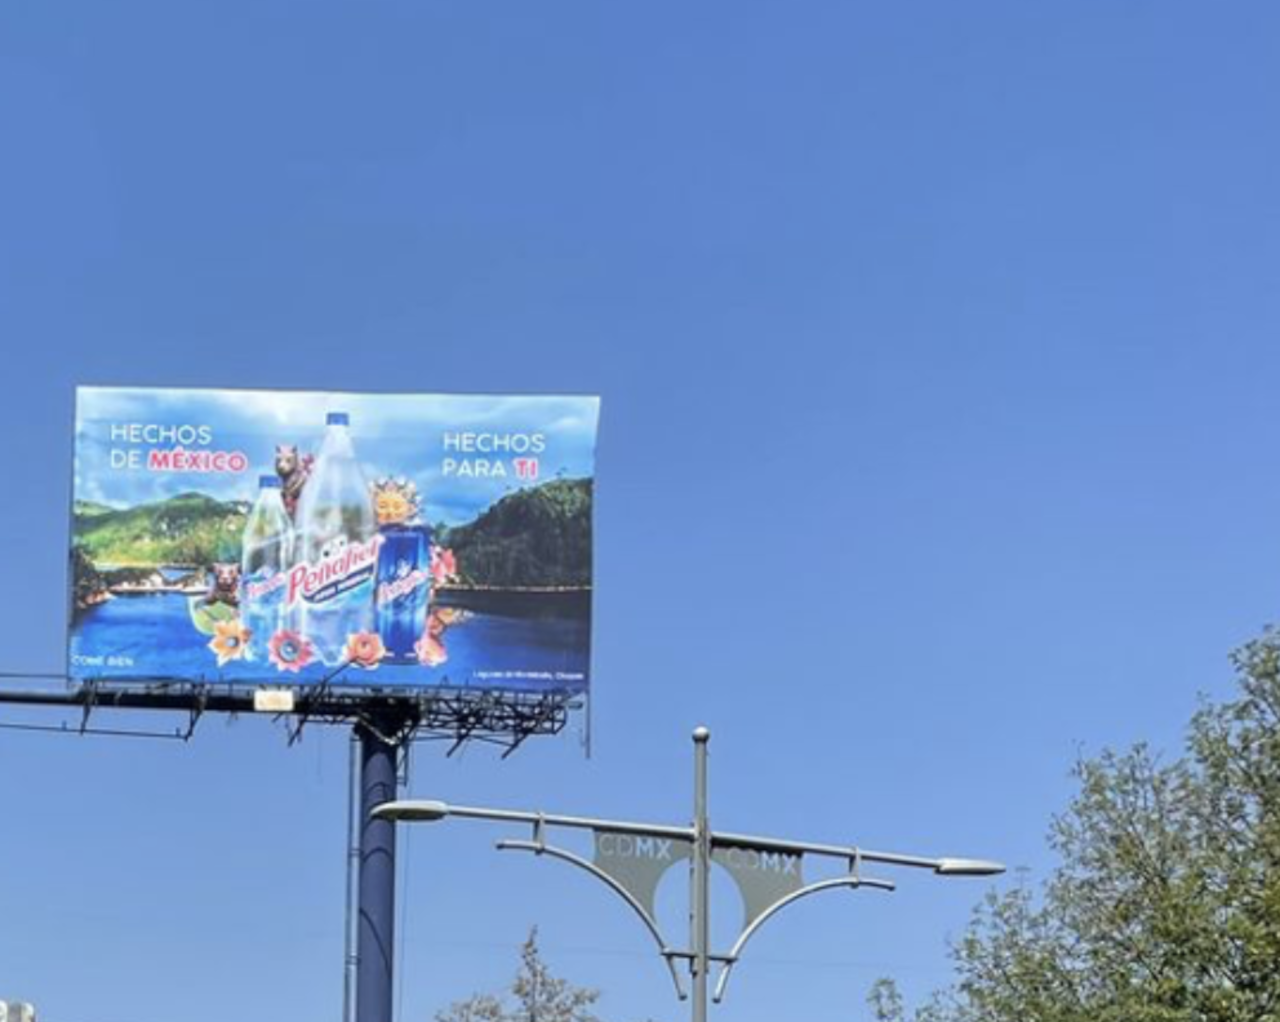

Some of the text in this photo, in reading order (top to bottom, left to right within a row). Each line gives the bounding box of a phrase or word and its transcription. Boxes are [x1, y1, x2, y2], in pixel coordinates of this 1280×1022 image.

[111, 424, 212, 445] HECHOS
[443, 433, 546, 453] HECHOS
[111, 445, 248, 472] DE MÉXICO
[442, 458, 538, 479] PARA TI
[599, 834, 670, 859] CDMX
[727, 848, 798, 875] CDMX
